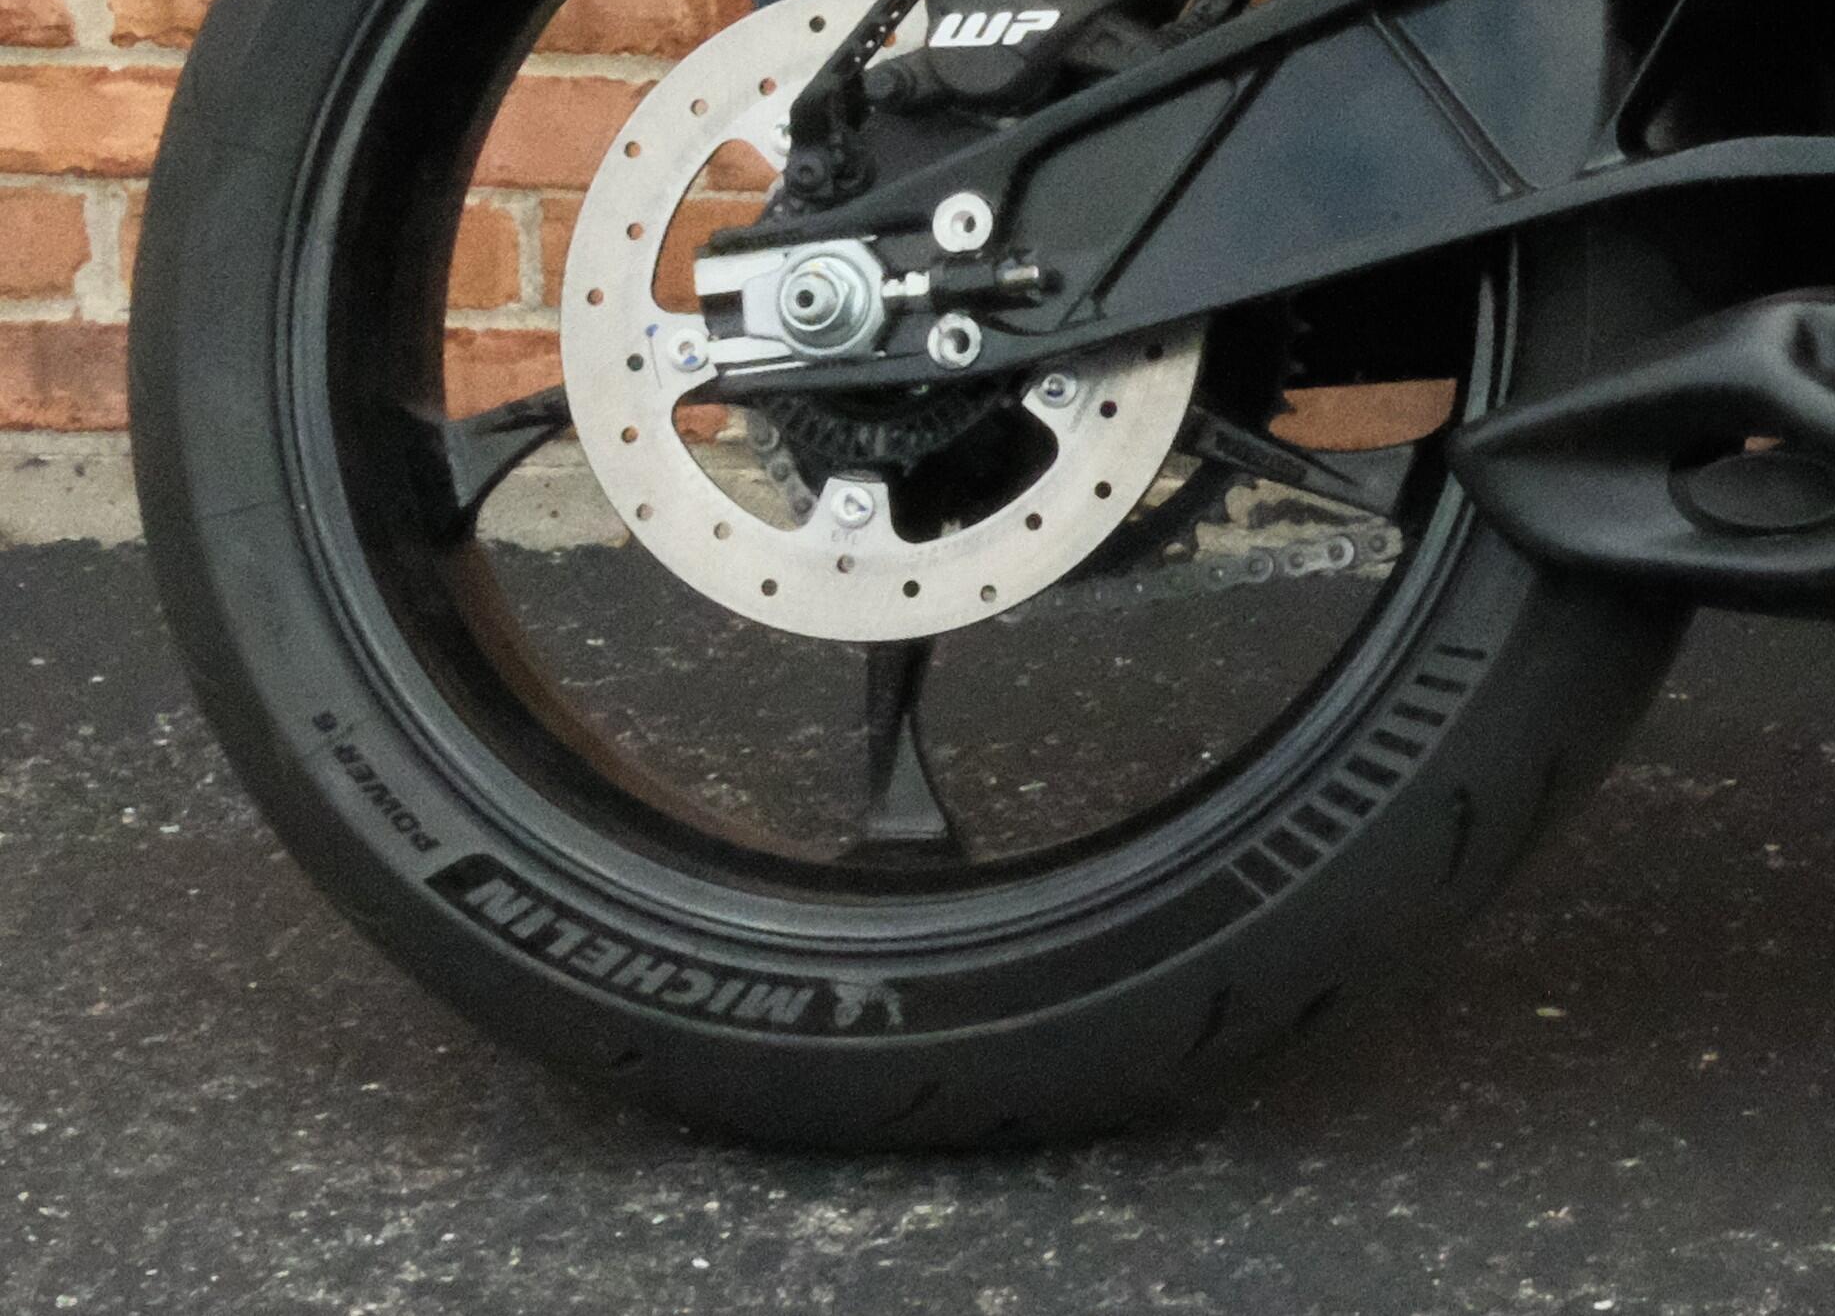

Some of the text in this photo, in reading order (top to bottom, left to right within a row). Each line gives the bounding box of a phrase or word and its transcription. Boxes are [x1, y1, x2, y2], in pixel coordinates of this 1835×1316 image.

[928, 10, 1061, 48] WP
[331, 739, 441, 855] POWER
[464, 871, 816, 1025] MICHELIN
